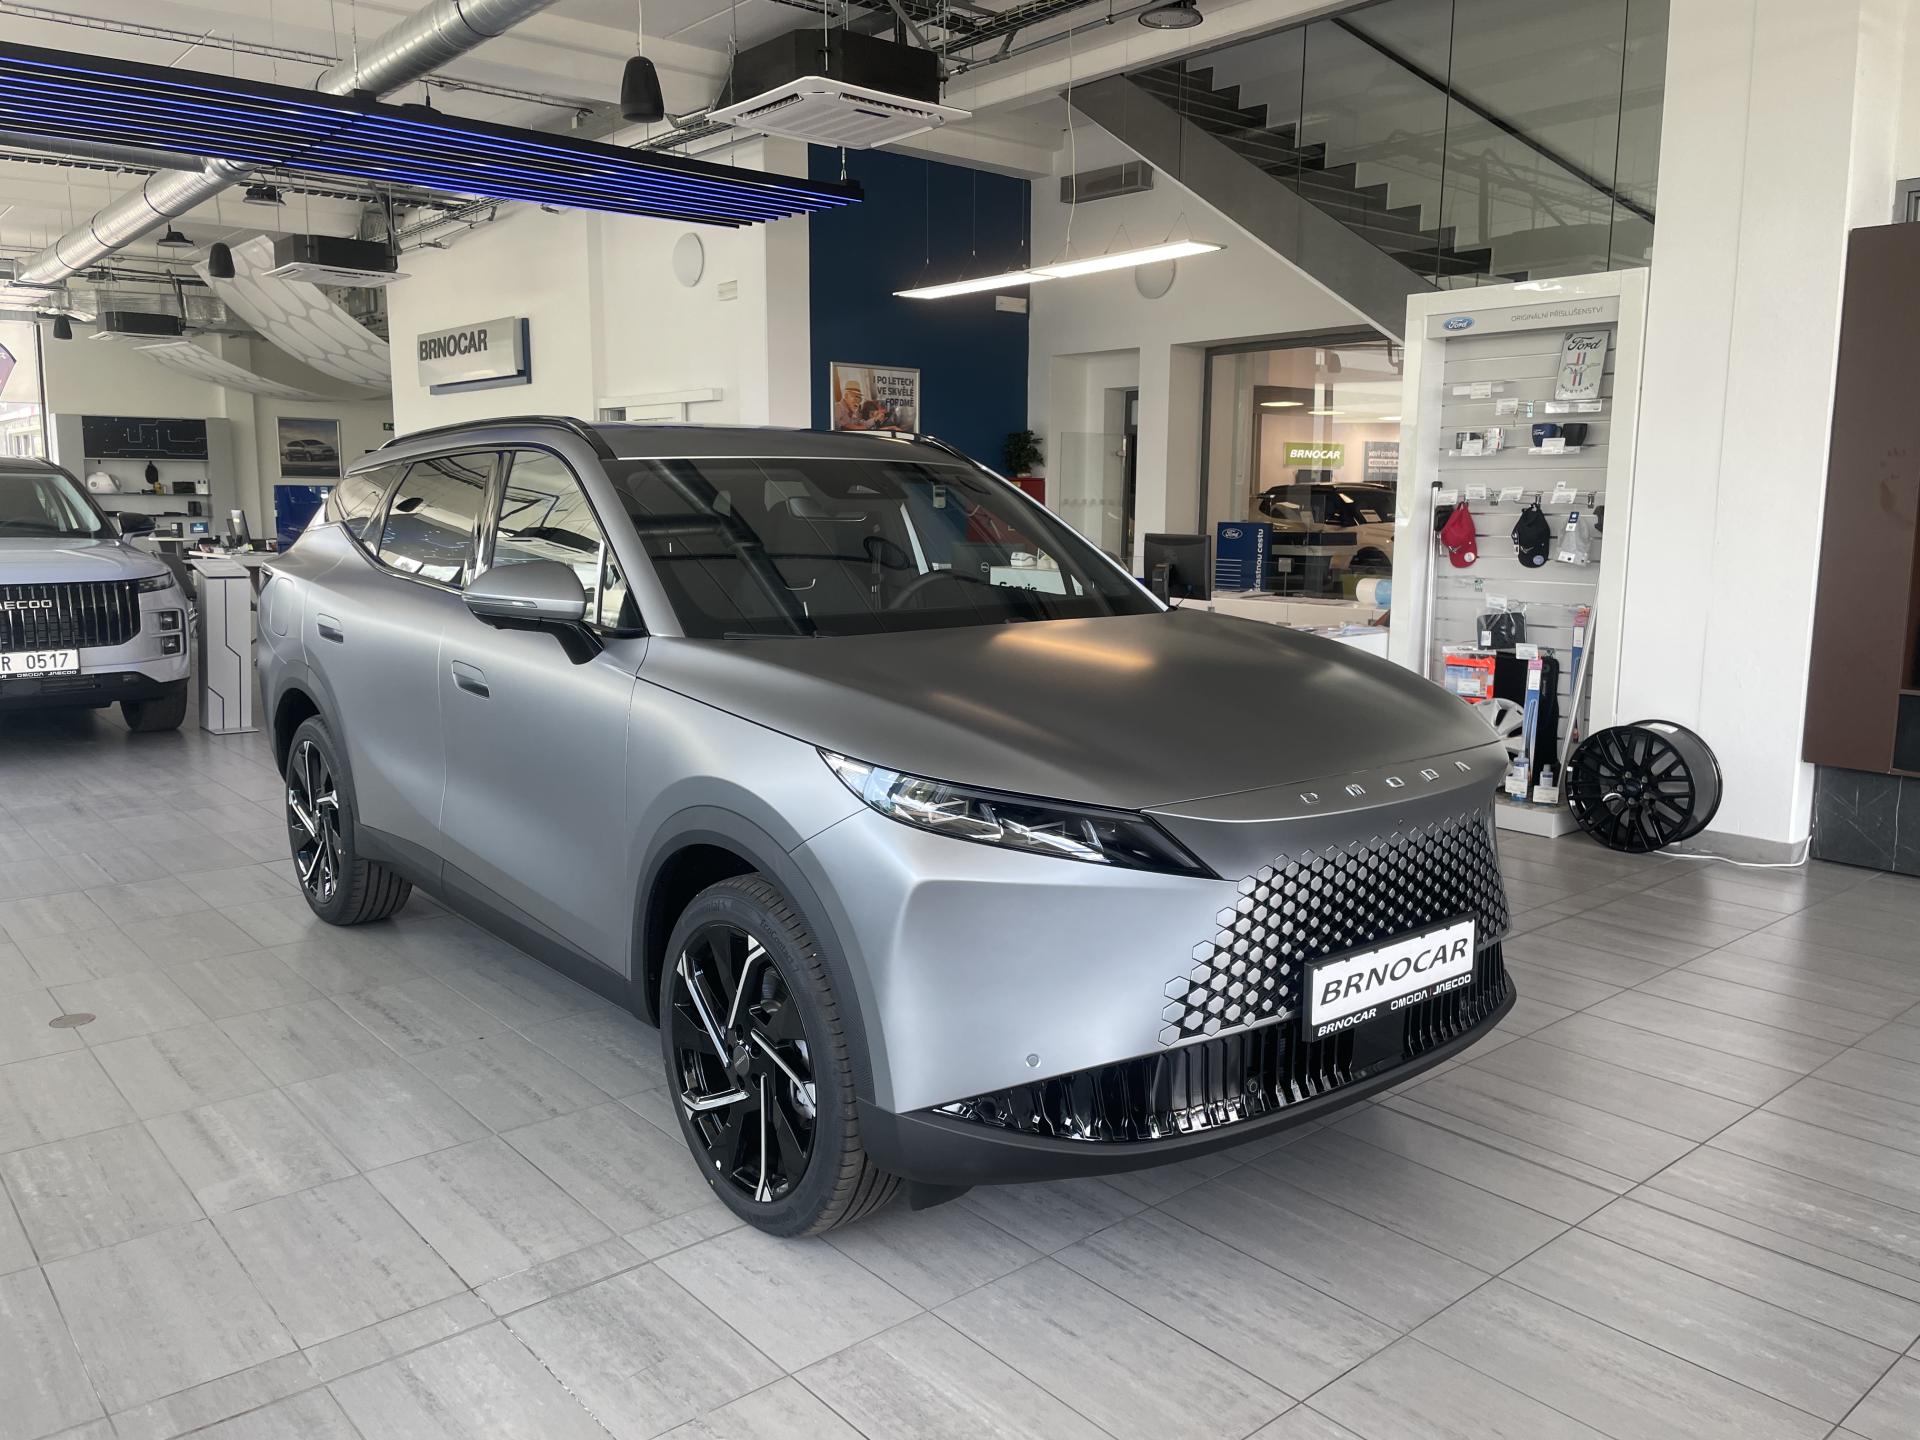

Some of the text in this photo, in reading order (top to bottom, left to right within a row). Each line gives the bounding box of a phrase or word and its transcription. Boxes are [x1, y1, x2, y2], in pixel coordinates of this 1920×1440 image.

[1448, 319, 1469, 329] Ford
[420, 329, 488, 361] BRNOCAR
[1567, 336, 1602, 351] Ford
[877, 376, 887, 385] PO
[888, 377, 914, 386] LETECH
[877, 387, 887, 395] VE
[1290, 449, 1341, 459] BRNOCAR
[26, 652, 69, 670] 0517
[1300, 761, 1471, 804] OMODA
[1320, 937, 1468, 1006] BRNOCAR
[1317, 974, 1472, 1037] BRNOCAR OMODA JAECOO
